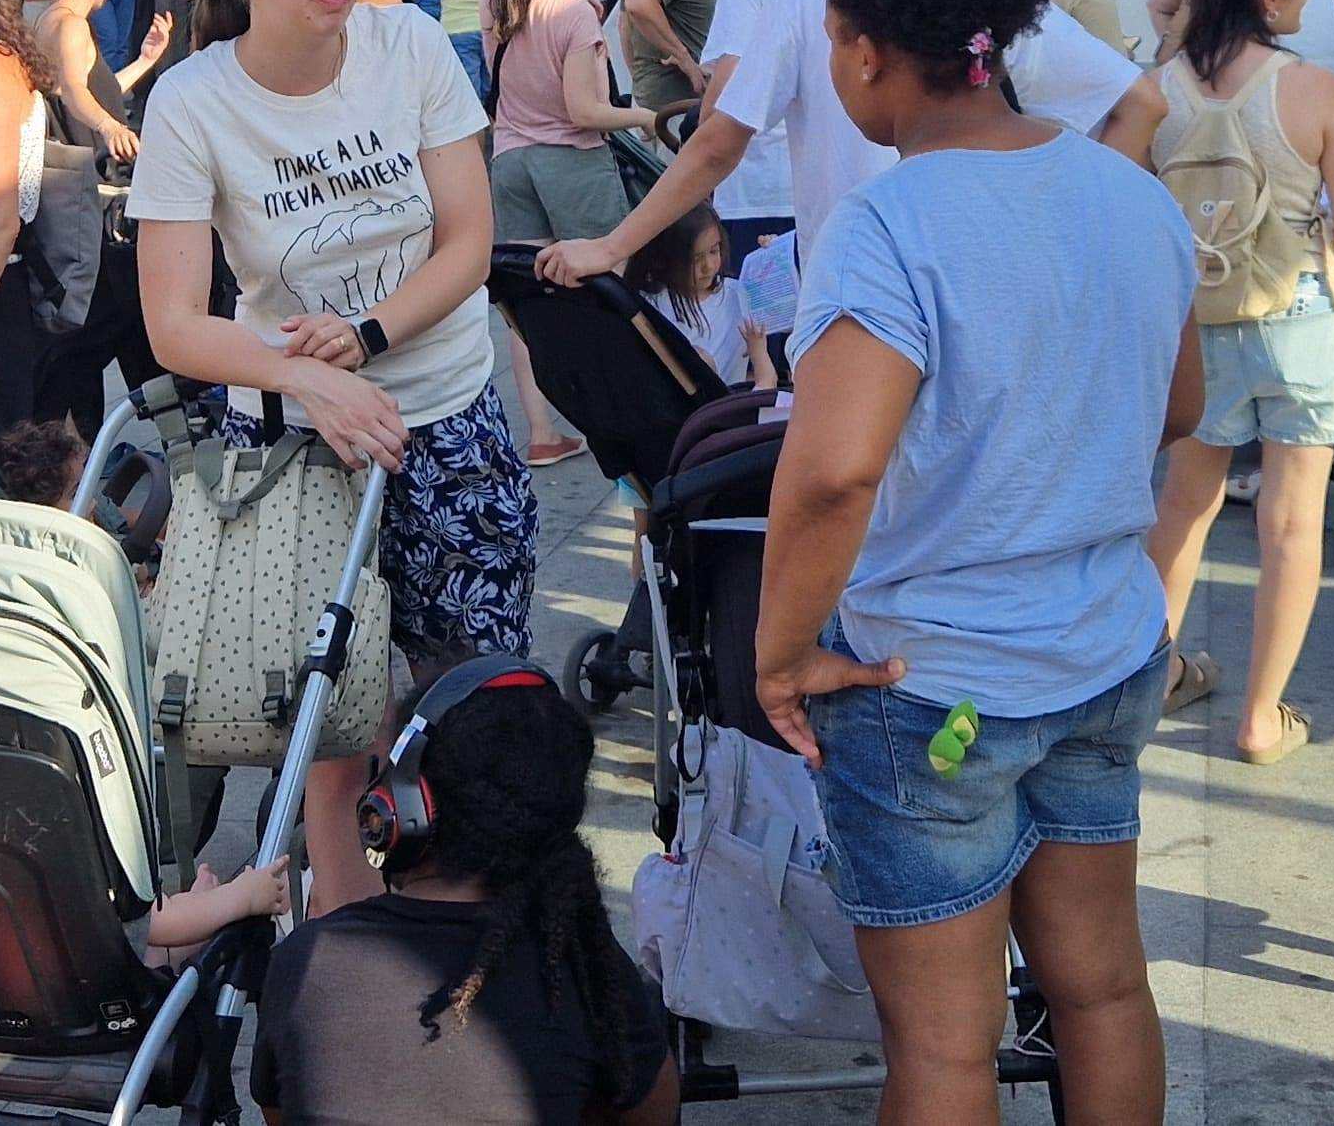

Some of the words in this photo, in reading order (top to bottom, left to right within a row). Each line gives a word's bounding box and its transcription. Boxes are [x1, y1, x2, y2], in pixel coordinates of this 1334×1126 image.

[264, 181, 325, 220] MEVA
[327, 152, 413, 201] MANERA
[274, 149, 331, 184] MARE
[336, 139, 352, 164] A
[354, 129, 383, 157] LA
